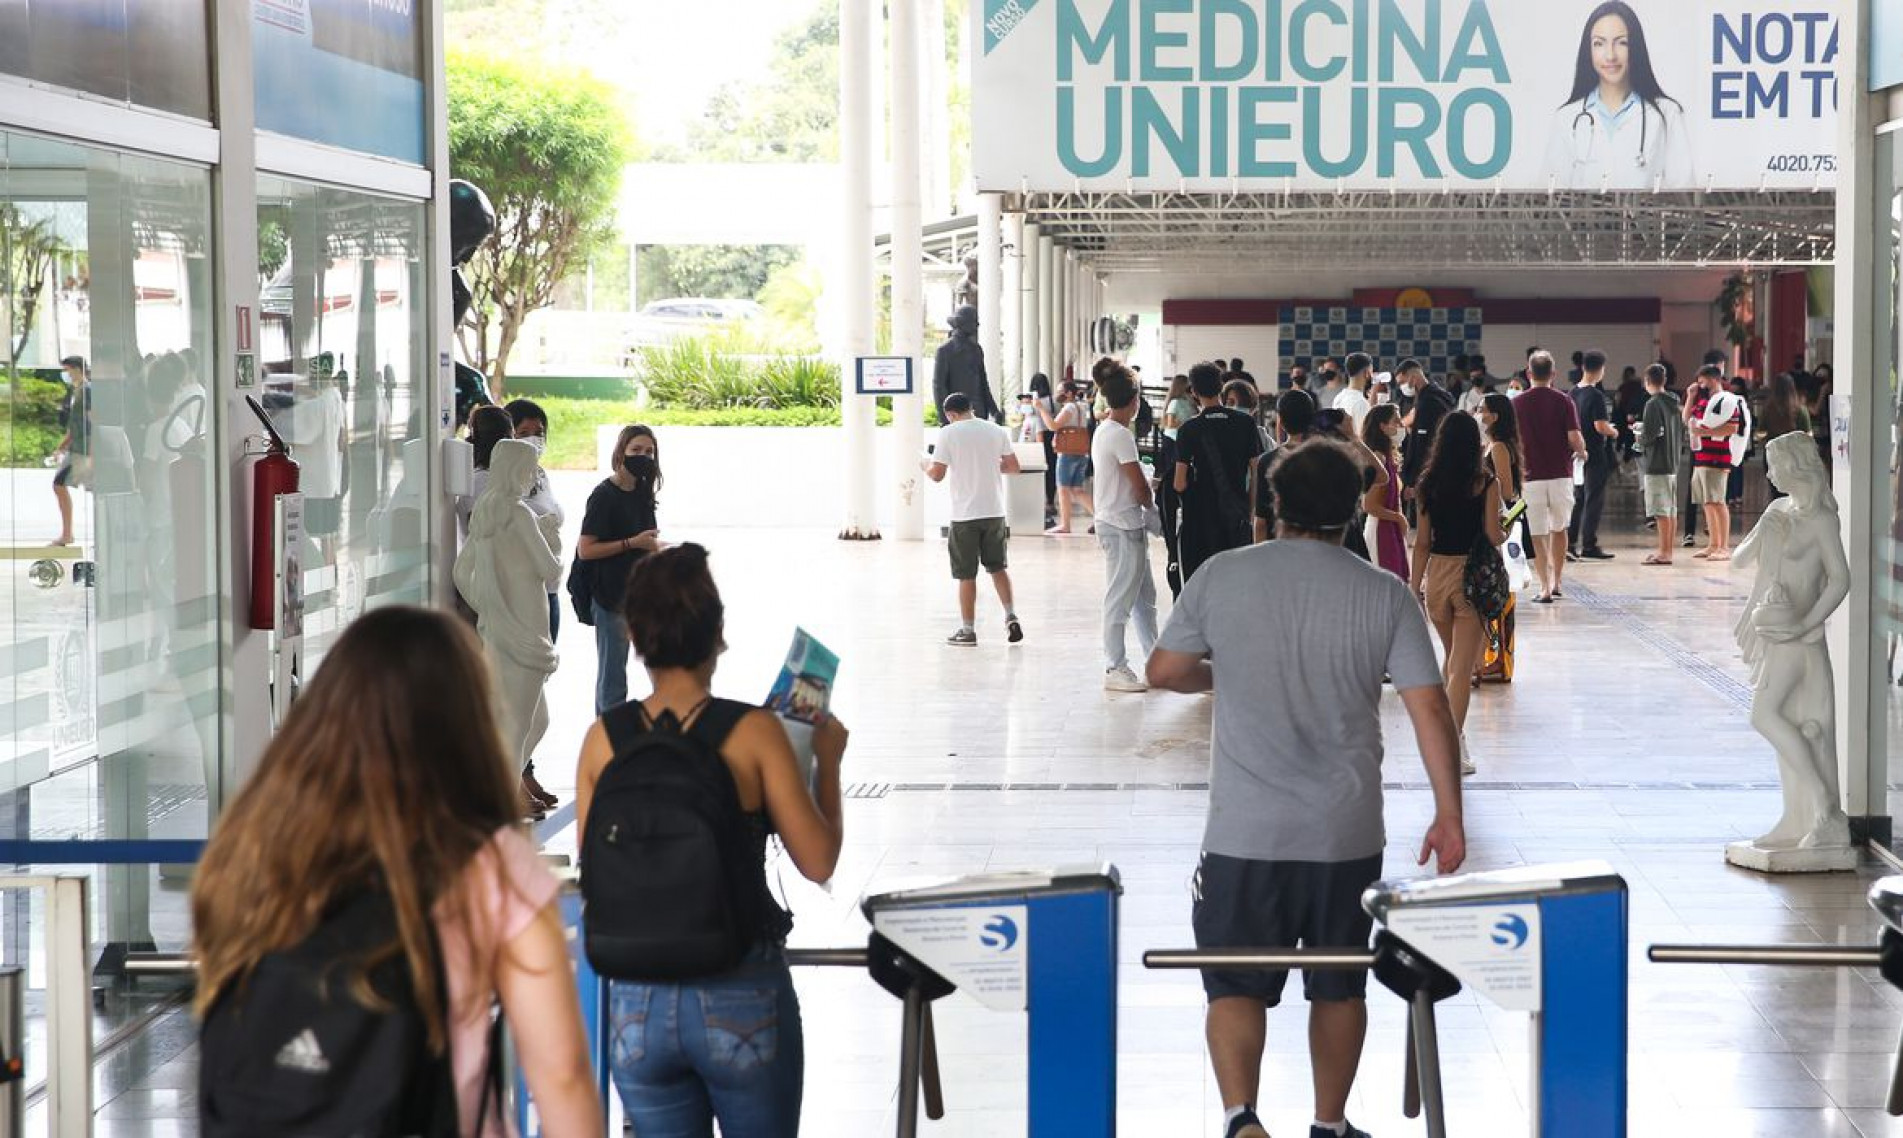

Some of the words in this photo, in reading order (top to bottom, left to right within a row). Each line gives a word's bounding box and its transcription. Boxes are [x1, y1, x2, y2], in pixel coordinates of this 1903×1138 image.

[986, 0, 1020, 35] NOVO
[1056, 0, 1512, 83] MEDICINA
[1712, 71, 1789, 119] EM
[1800, 71, 1839, 118] T
[1056, 86, 1513, 180] UNIEURO
